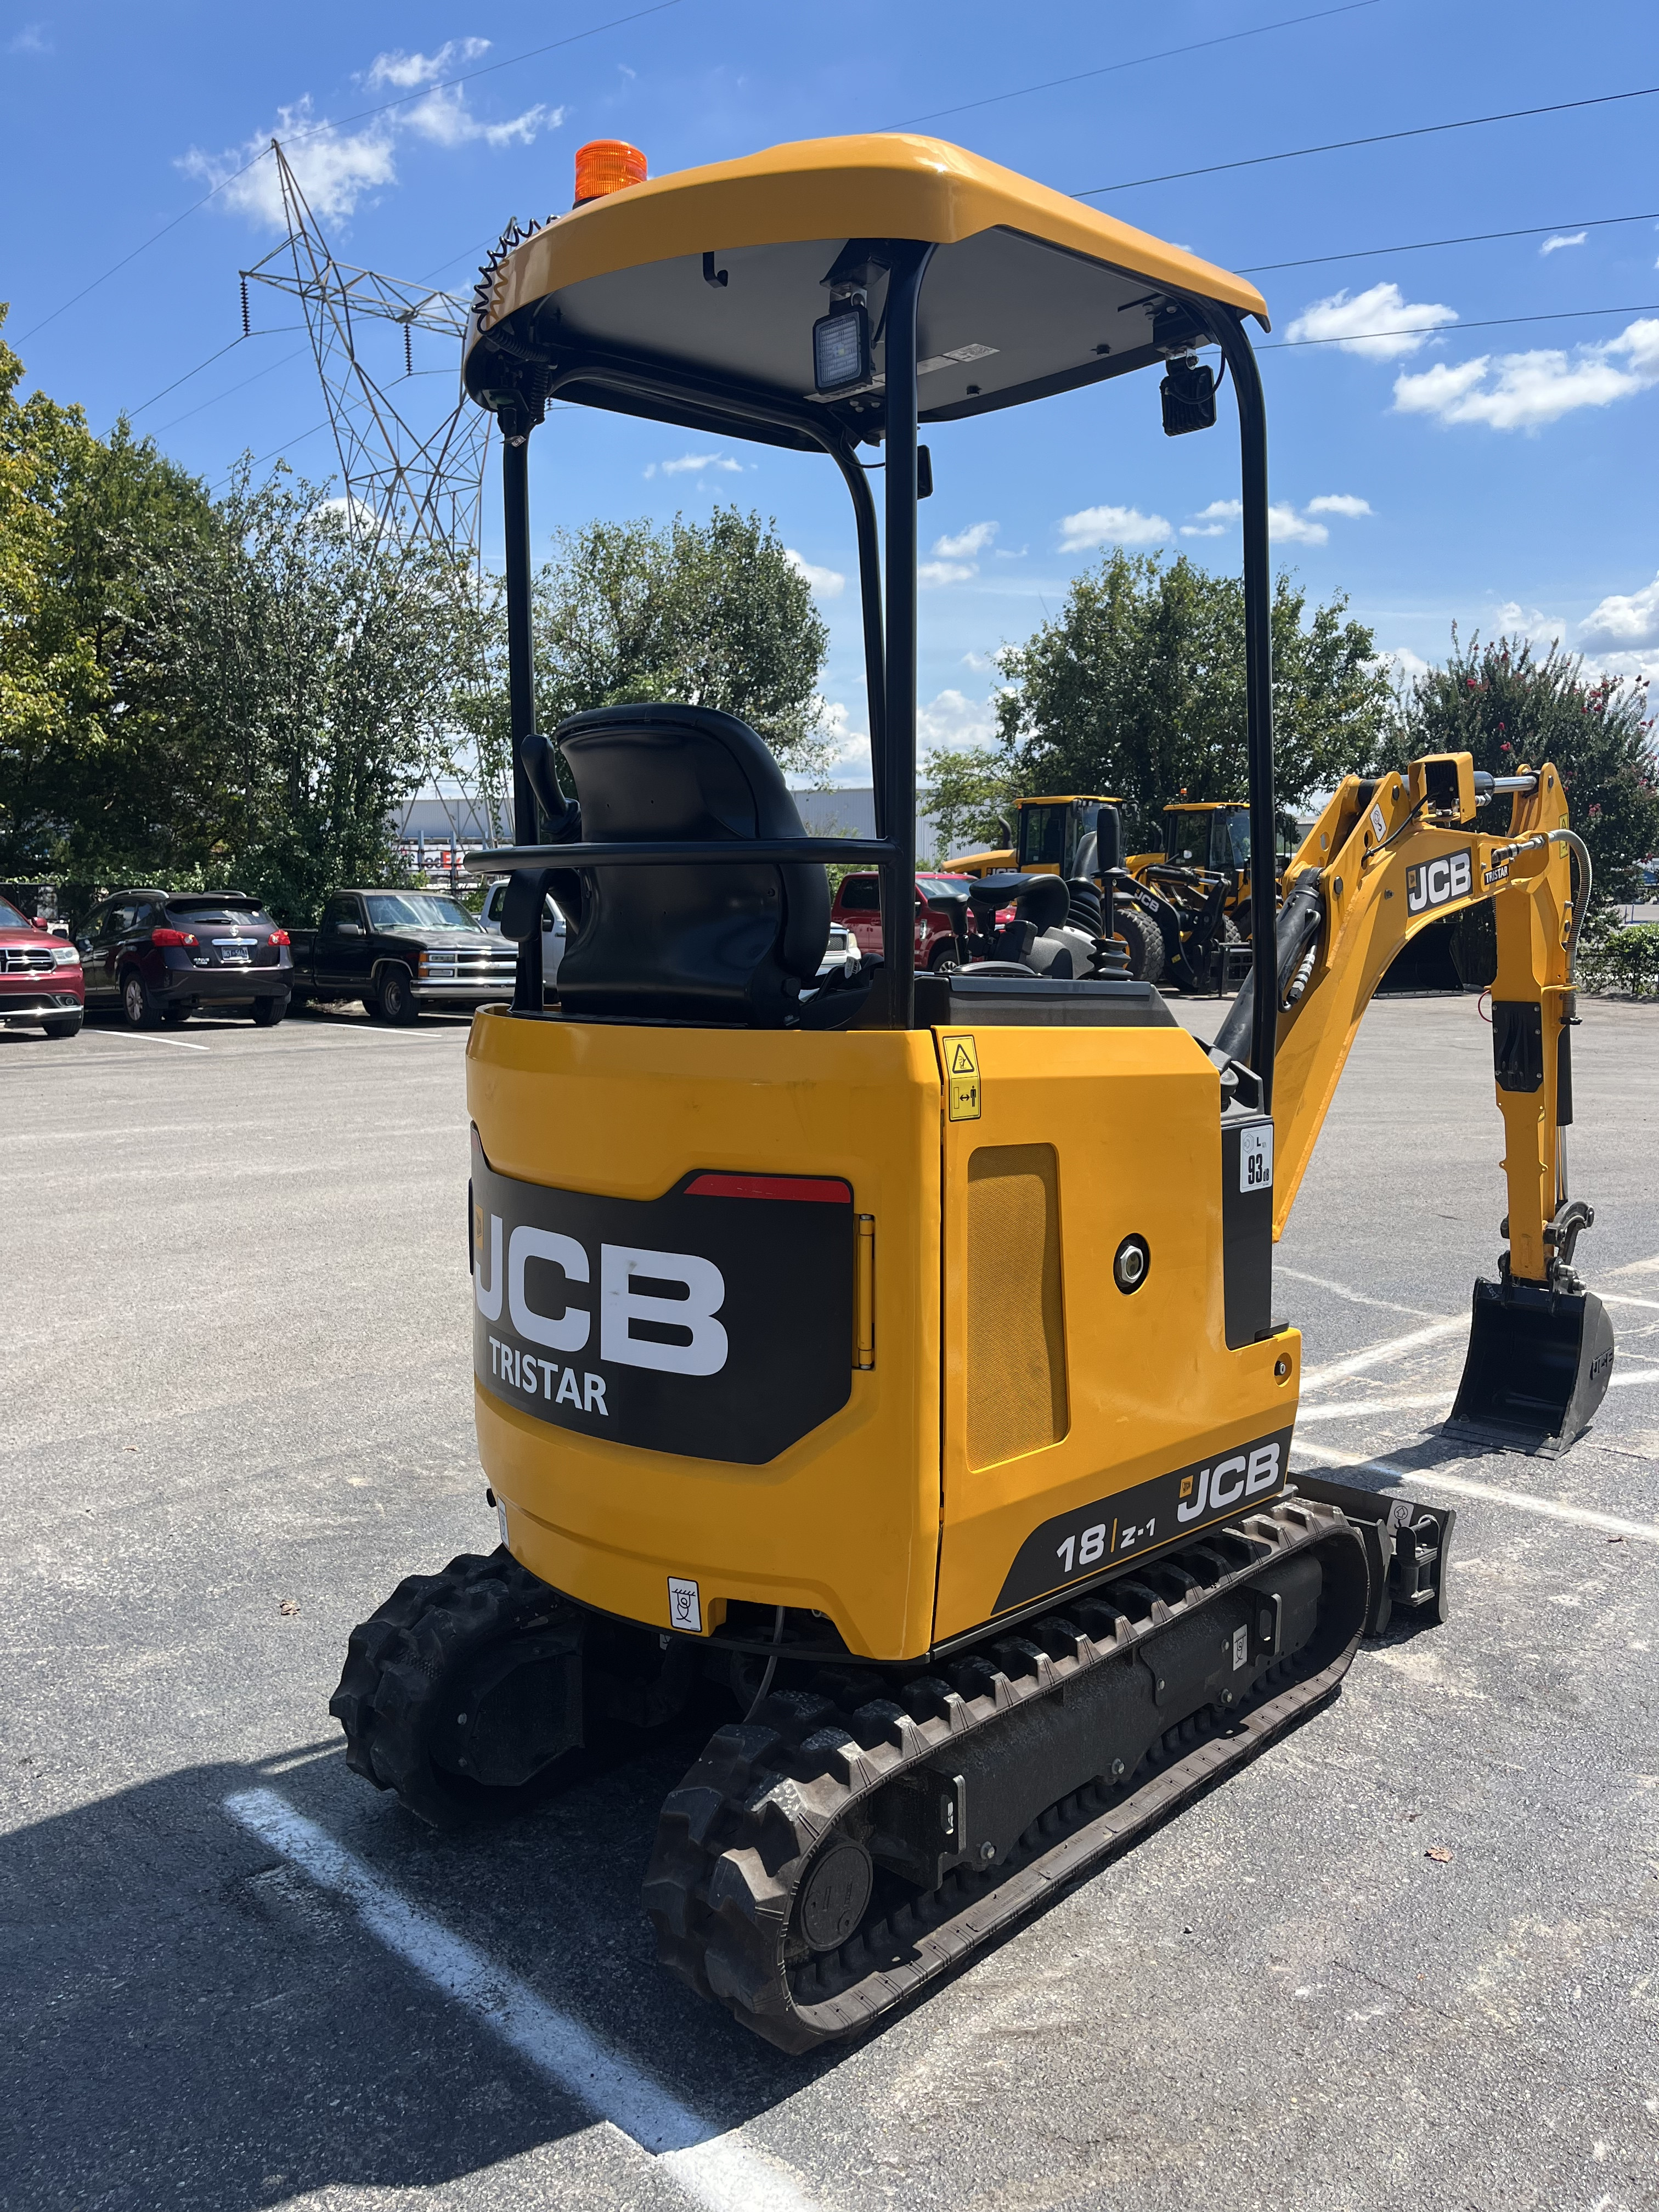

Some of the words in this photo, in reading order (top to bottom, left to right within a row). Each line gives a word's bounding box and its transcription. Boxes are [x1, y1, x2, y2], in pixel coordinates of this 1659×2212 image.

[420, 851, 462, 869] edEx
[1408, 853, 1471, 911] JCB
[1485, 865, 1508, 884] TRISTAR
[1134, 891, 1159, 912] JCB
[476, 1213, 729, 1376] JCB
[489, 1335, 609, 1416] TRISTAR
[1177, 1442, 1280, 1522] JCB
[1056, 1523, 1106, 1573] 18
